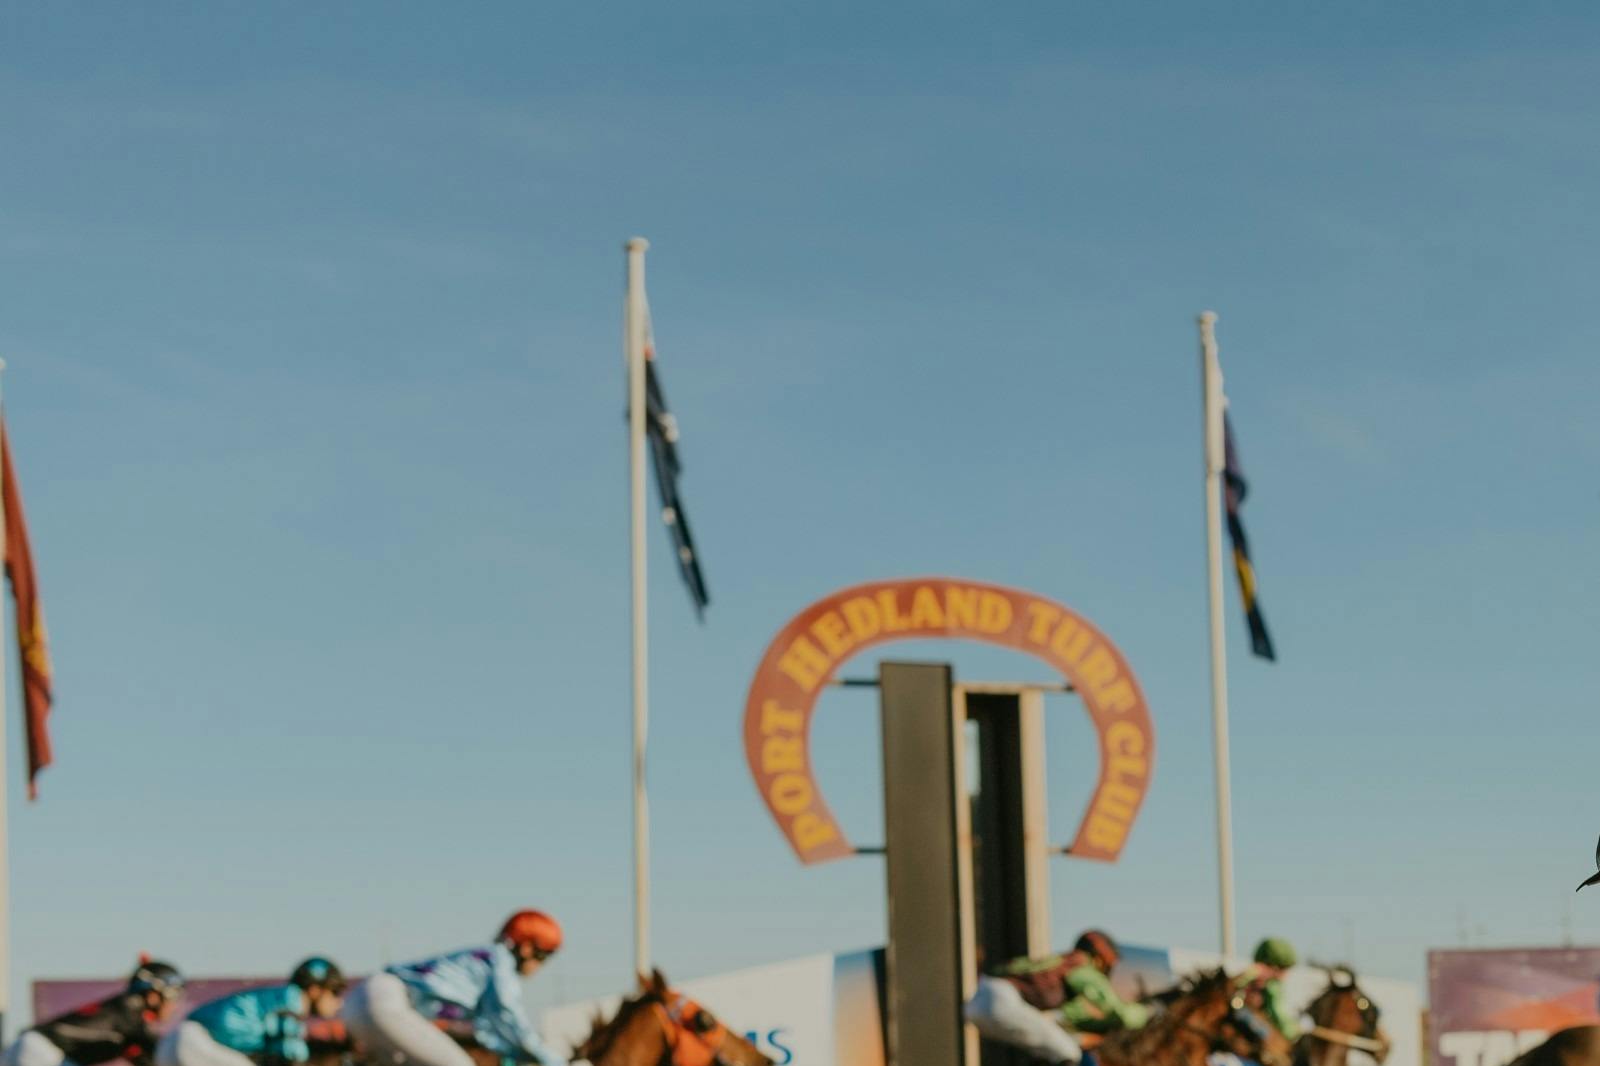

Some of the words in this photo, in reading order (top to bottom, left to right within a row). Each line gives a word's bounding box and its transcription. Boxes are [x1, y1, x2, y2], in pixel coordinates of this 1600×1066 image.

[777, 586, 1013, 693] HEDLAND
[1026, 601, 1137, 714] TURF
[760, 699, 834, 852] PORT
[1087, 720, 1147, 853] CLUB
